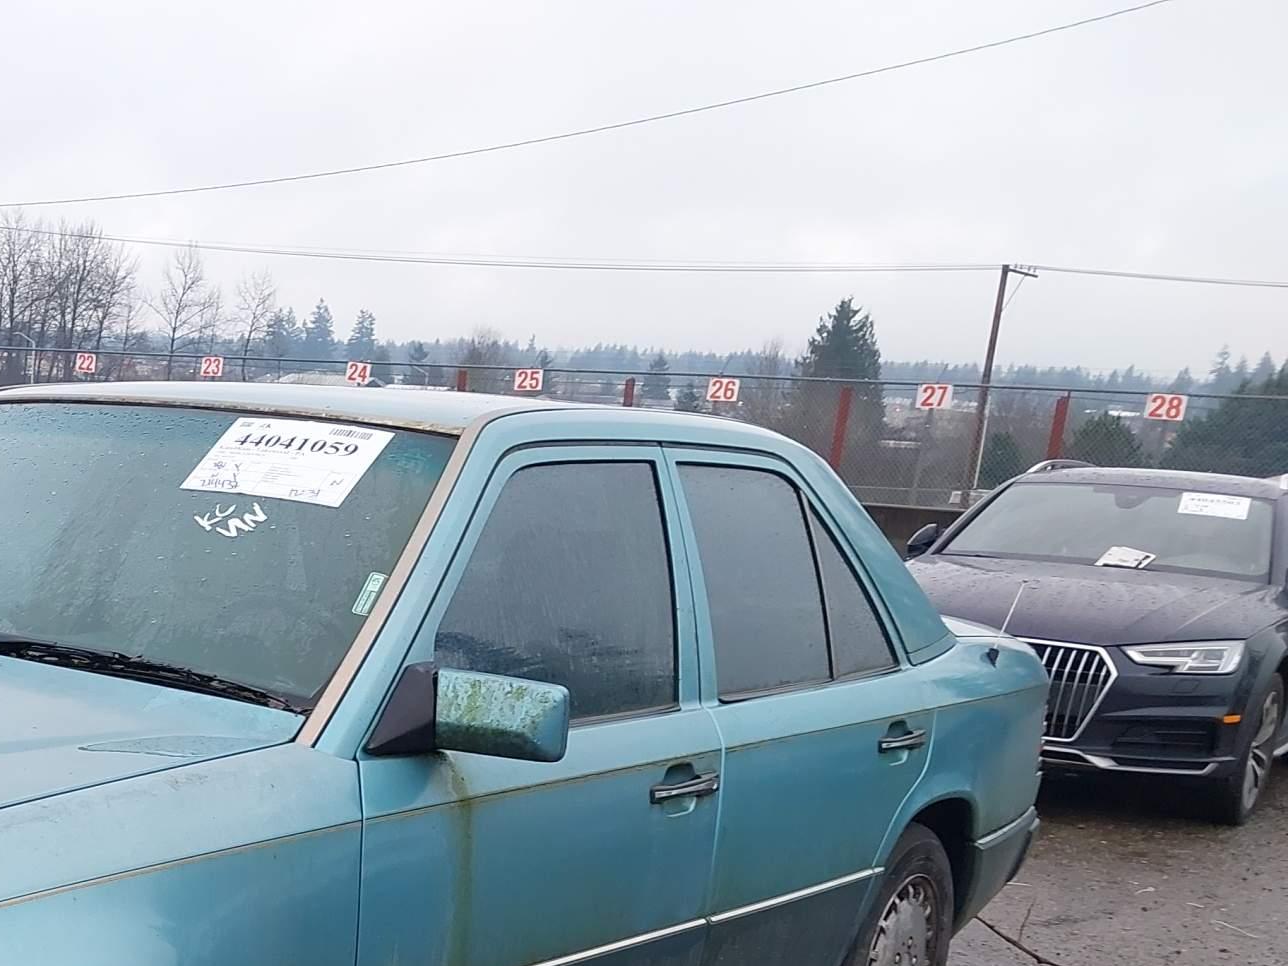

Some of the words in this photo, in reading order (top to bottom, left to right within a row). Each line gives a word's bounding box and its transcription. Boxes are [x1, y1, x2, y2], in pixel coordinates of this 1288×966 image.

[78, 355, 94, 371] 22
[202, 359, 221, 375] 23
[348, 364, 368, 383] 24
[516, 371, 540, 389] 25
[709, 380, 736, 400] 26
[920, 386, 948, 407] 27
[1148, 395, 1182, 418] 28
[234, 433, 359, 456] 44041059
